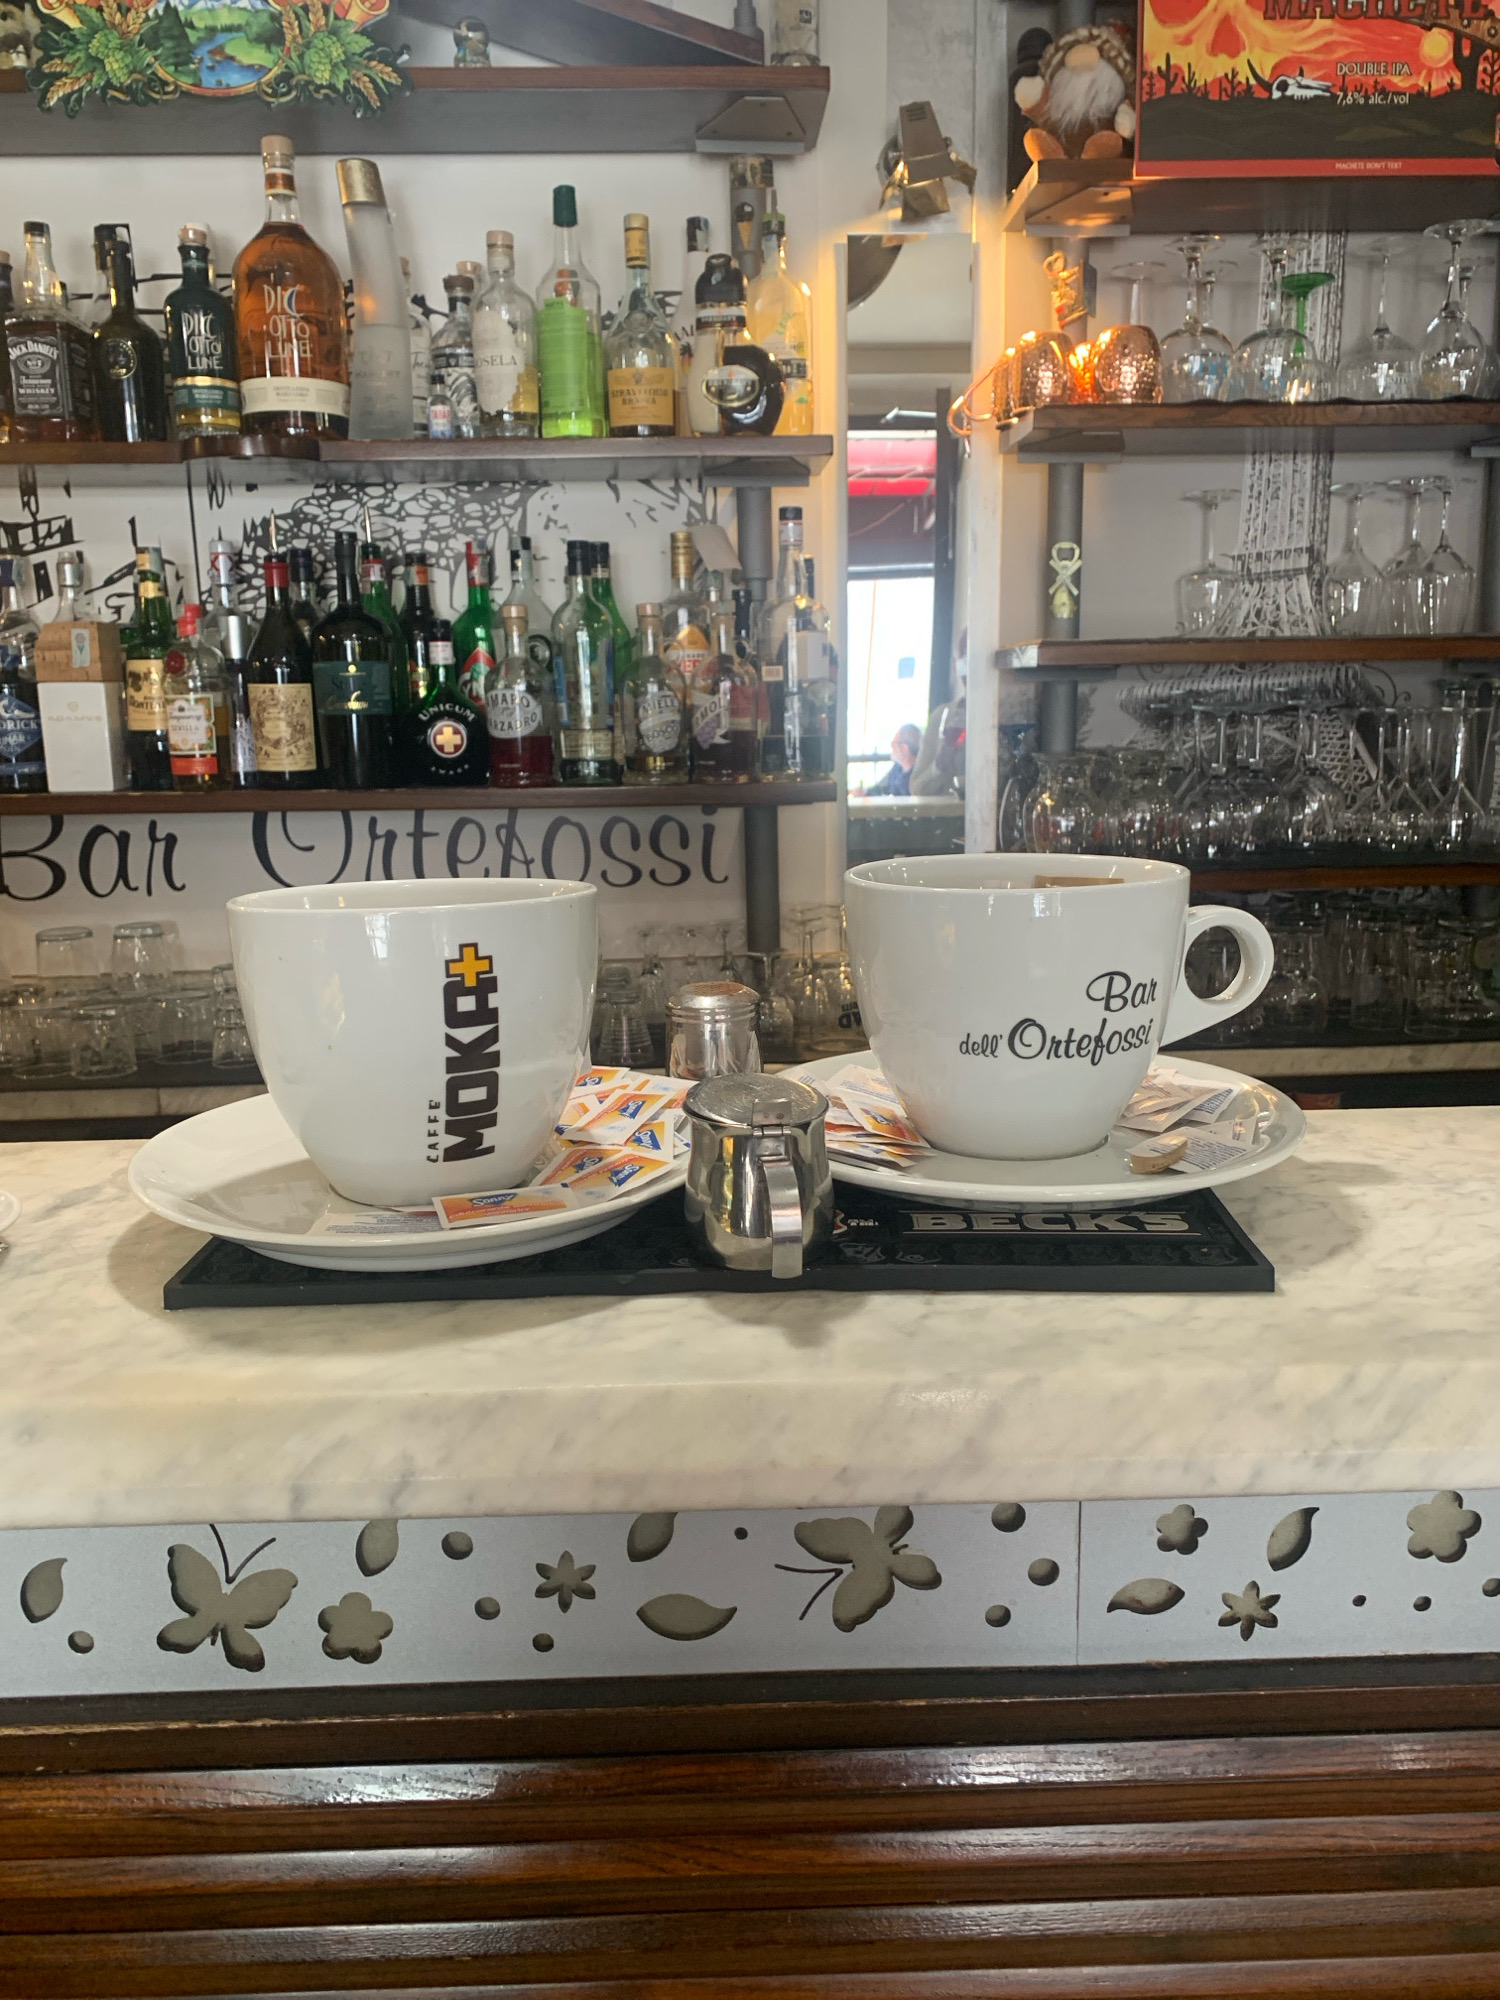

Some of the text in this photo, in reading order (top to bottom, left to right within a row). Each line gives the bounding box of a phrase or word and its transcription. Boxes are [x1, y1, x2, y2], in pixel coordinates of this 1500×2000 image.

[1336, 62, 1412, 77] DOUBLE IPA
[1336, 92, 1365, 106] 7,6%
[8, 344, 28, 360] JACK
[187, 356, 223, 370] LUNE
[418, 703, 476, 722] UNICUM
[0, 812, 187, 901] Bar
[1086, 970, 1158, 1012] Bar
[959, 1017, 1154, 1067] dell' Ortefossi
[472, 1192, 514, 1207] Sonny
[910, 1211, 1191, 1232] BECK'S
